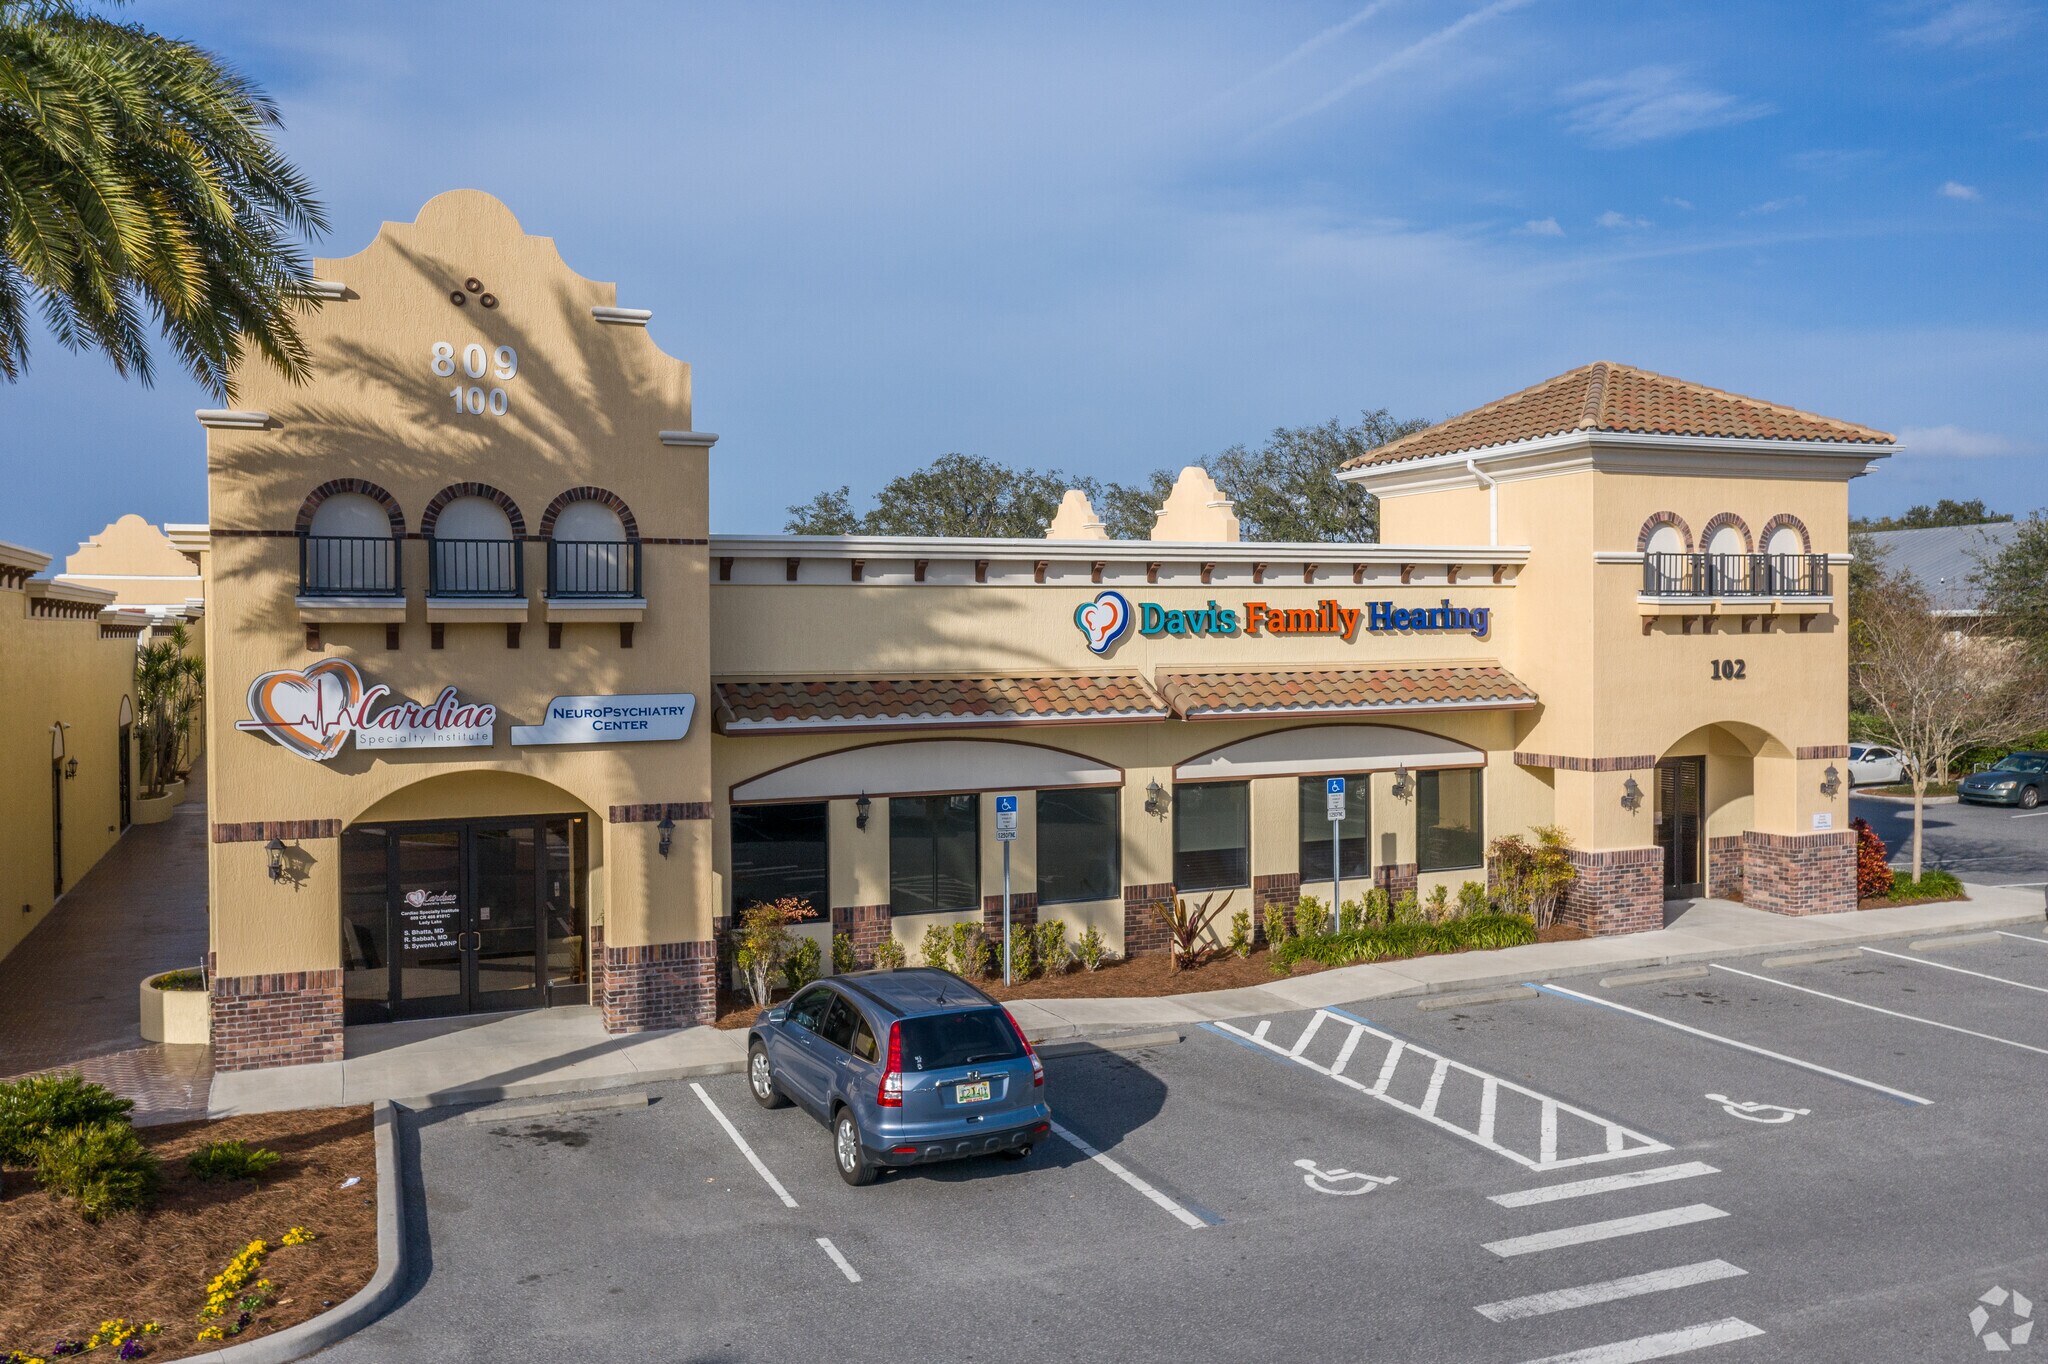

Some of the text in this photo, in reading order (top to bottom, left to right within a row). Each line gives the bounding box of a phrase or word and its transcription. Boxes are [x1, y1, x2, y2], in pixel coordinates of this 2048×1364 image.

[431, 341, 518, 380] 809
[449, 386, 508, 416] 100
[1138, 598, 1490, 639] Davis Family Hearing
[1710, 659, 1746, 681] 102
[357, 687, 493, 730] Cardiac
[360, 731, 489, 745] Specialty Institute
